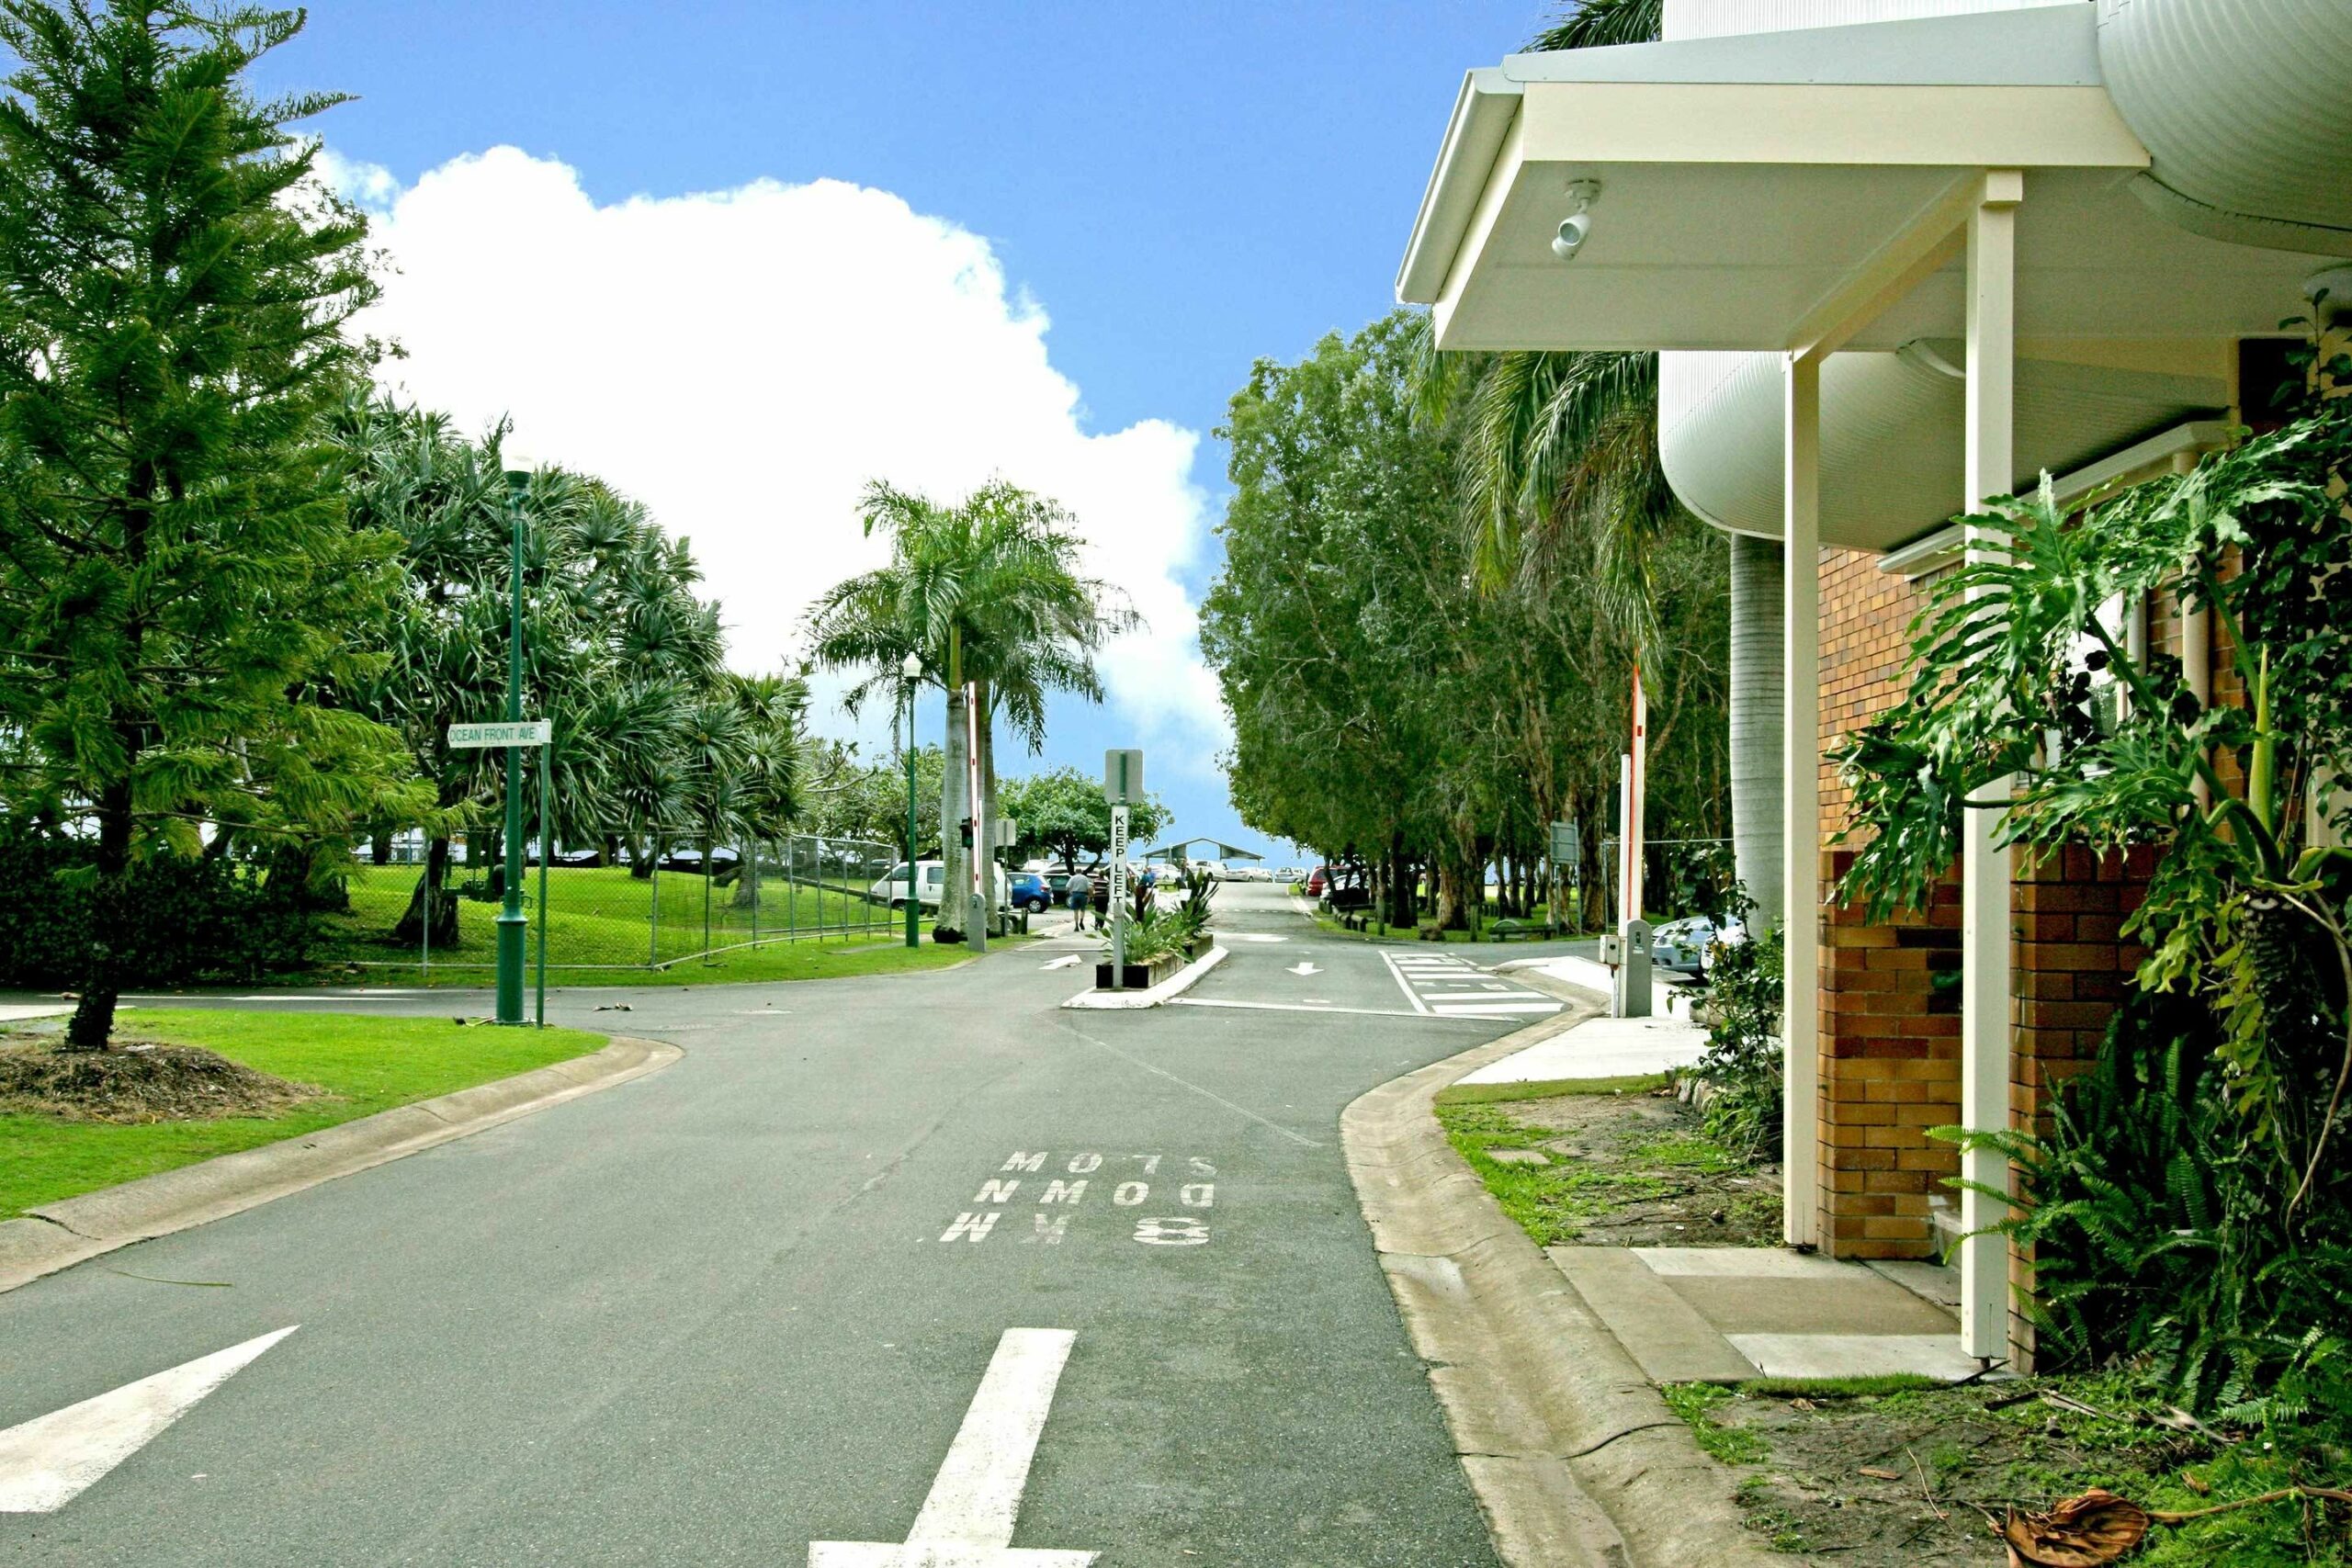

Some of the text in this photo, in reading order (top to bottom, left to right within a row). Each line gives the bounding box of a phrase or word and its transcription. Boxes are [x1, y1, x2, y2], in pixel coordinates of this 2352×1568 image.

[449, 727, 535, 742] OCEAN FRONT AVE
[1114, 815, 1125, 903] KEEP LEFT
[1000, 1150, 1217, 1177] SLOW
[973, 1179, 1215, 1207] DOWN
[1132, 1216, 1210, 1247] 8
